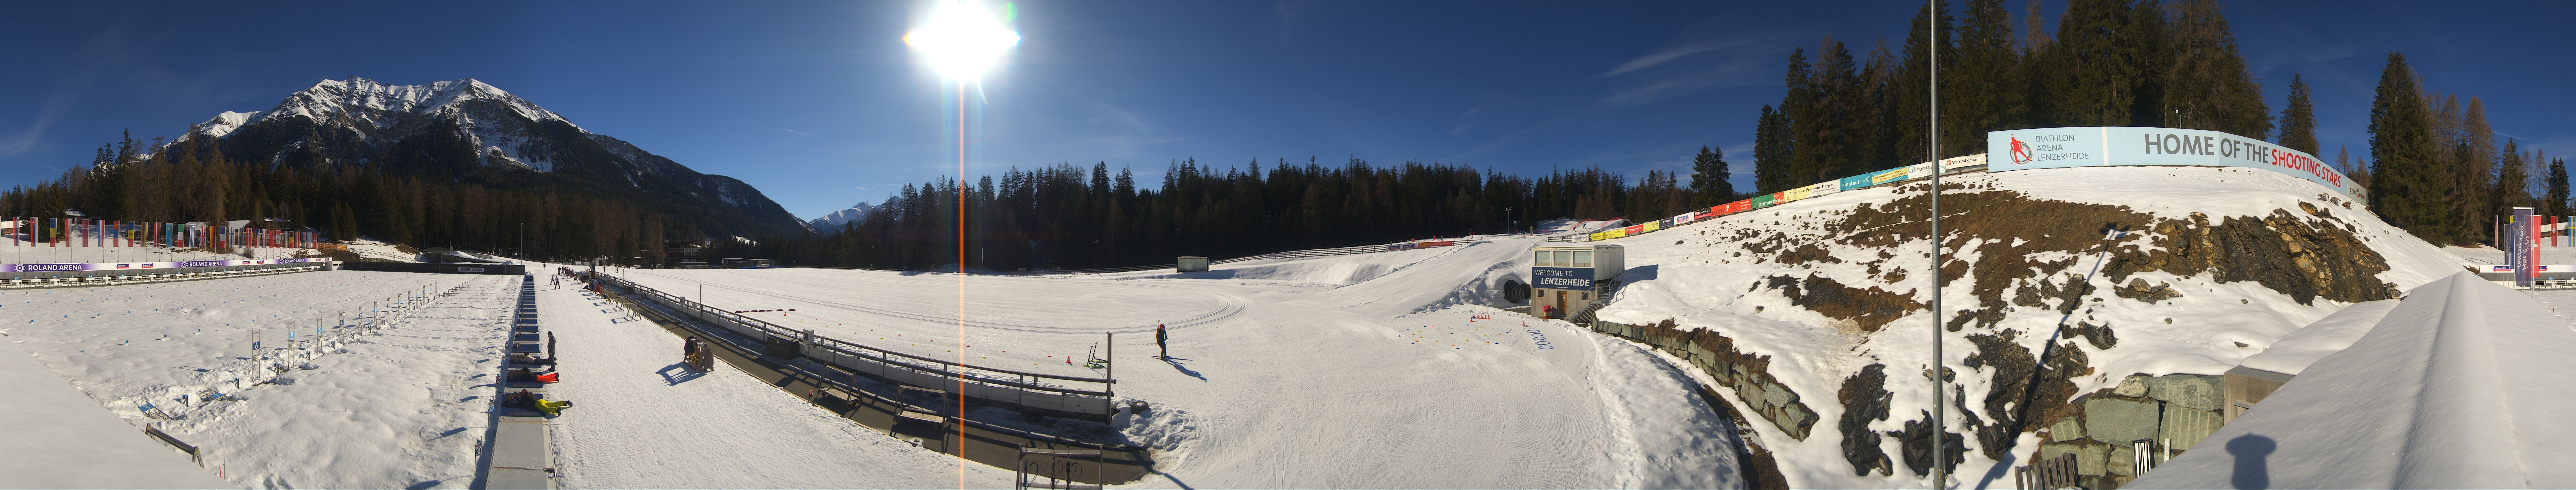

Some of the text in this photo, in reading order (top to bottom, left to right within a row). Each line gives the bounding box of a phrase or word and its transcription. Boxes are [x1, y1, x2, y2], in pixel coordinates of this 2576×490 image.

[2038, 153, 2089, 161] LENZERHEIDE
[2145, 133, 2341, 188] HOME OF THE SHOOTING STARS
[1841, 179, 1865, 187] langlauf.ch
[1759, 198, 1784, 207] parpanbau
[1541, 278, 1590, 286] LENZERHEIDE
